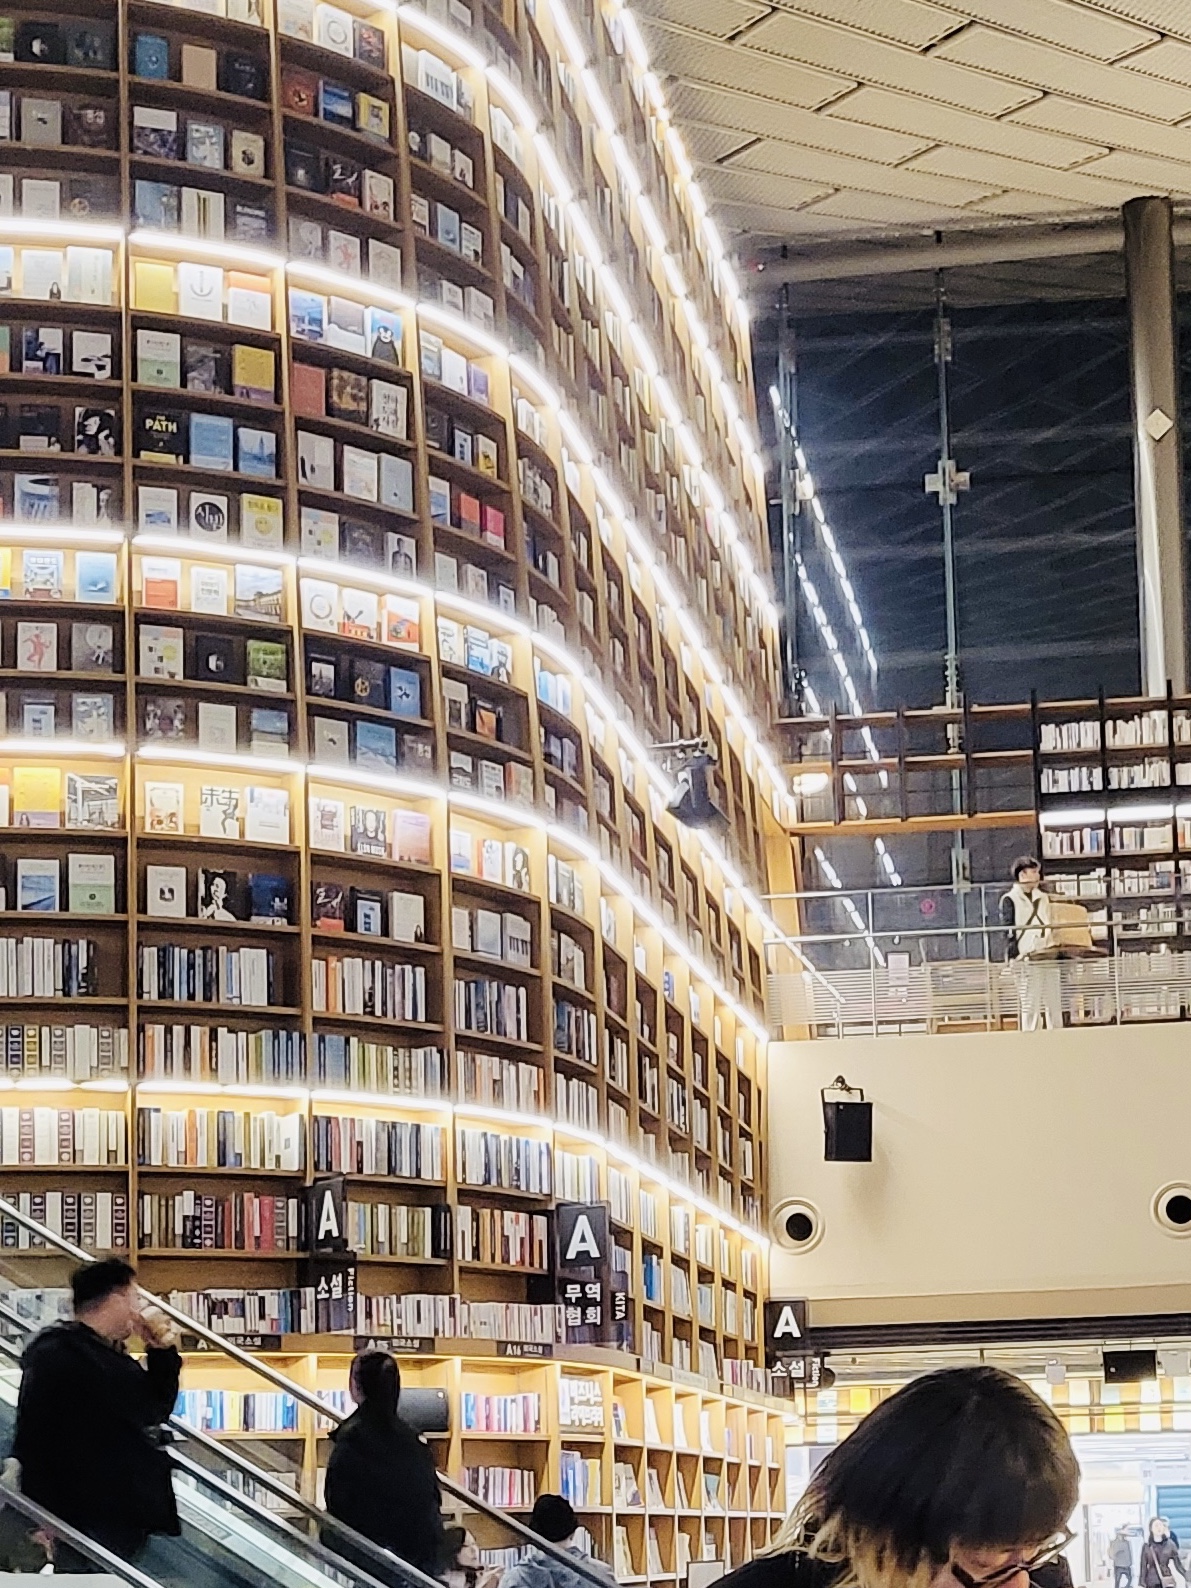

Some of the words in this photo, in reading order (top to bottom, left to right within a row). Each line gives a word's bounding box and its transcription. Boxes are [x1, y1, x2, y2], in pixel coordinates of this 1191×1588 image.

[144, 418, 178, 433] PATH
[317, 1189, 340, 1240] A
[565, 1214, 600, 1260] A
[316, 1272, 343, 1300] 소설
[565, 1282, 601, 1303] 무역
[565, 1306, 601, 1327] 협회
[615, 1291, 626, 1320] KITA
[773, 1305, 802, 1338] A
[771, 1360, 805, 1378] 소설
